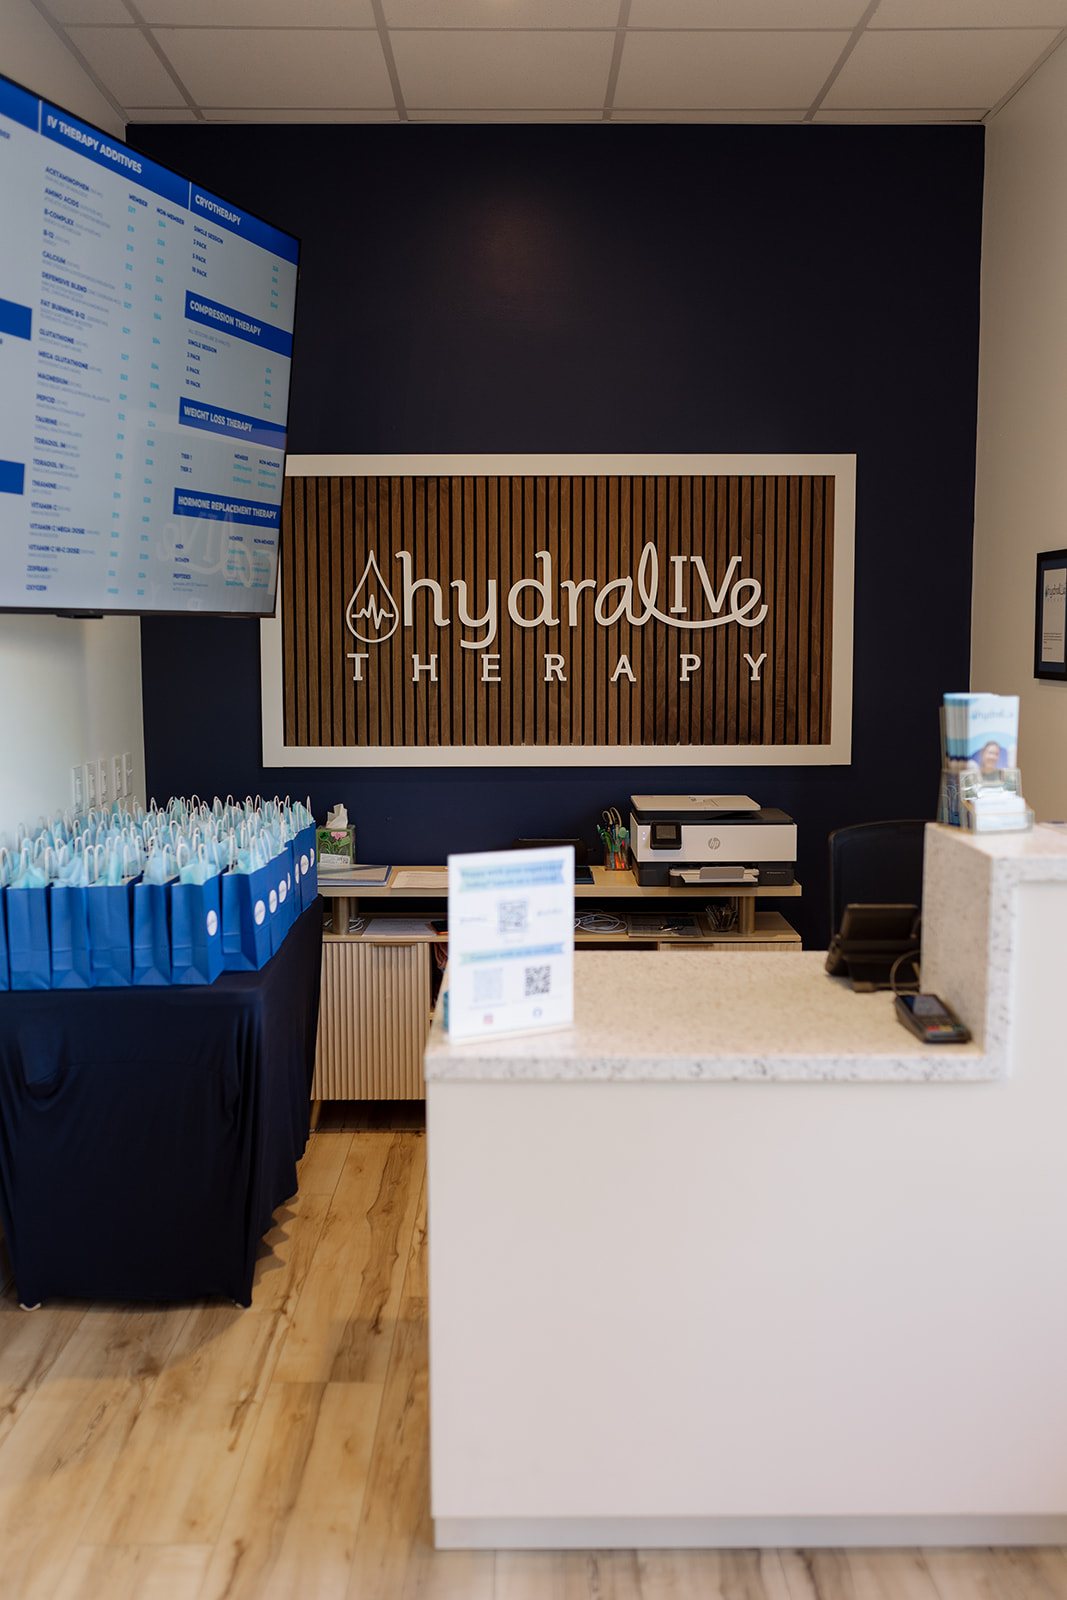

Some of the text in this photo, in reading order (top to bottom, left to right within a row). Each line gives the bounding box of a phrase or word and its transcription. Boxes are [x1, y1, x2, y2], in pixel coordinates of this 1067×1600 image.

[47, 115, 142, 174] IV THERAPY ADDITIVES
[194, 194, 241, 226] CRYOTHERAPY
[190, 300, 261, 336] COMPRESSION THERAPY
[184, 406, 253, 432] WEIGHT LOSS THERAPY
[178, 496, 277, 519] HORMONE REPLACEMENT THERAPY
[346, 652, 768, 682] THERAPY
